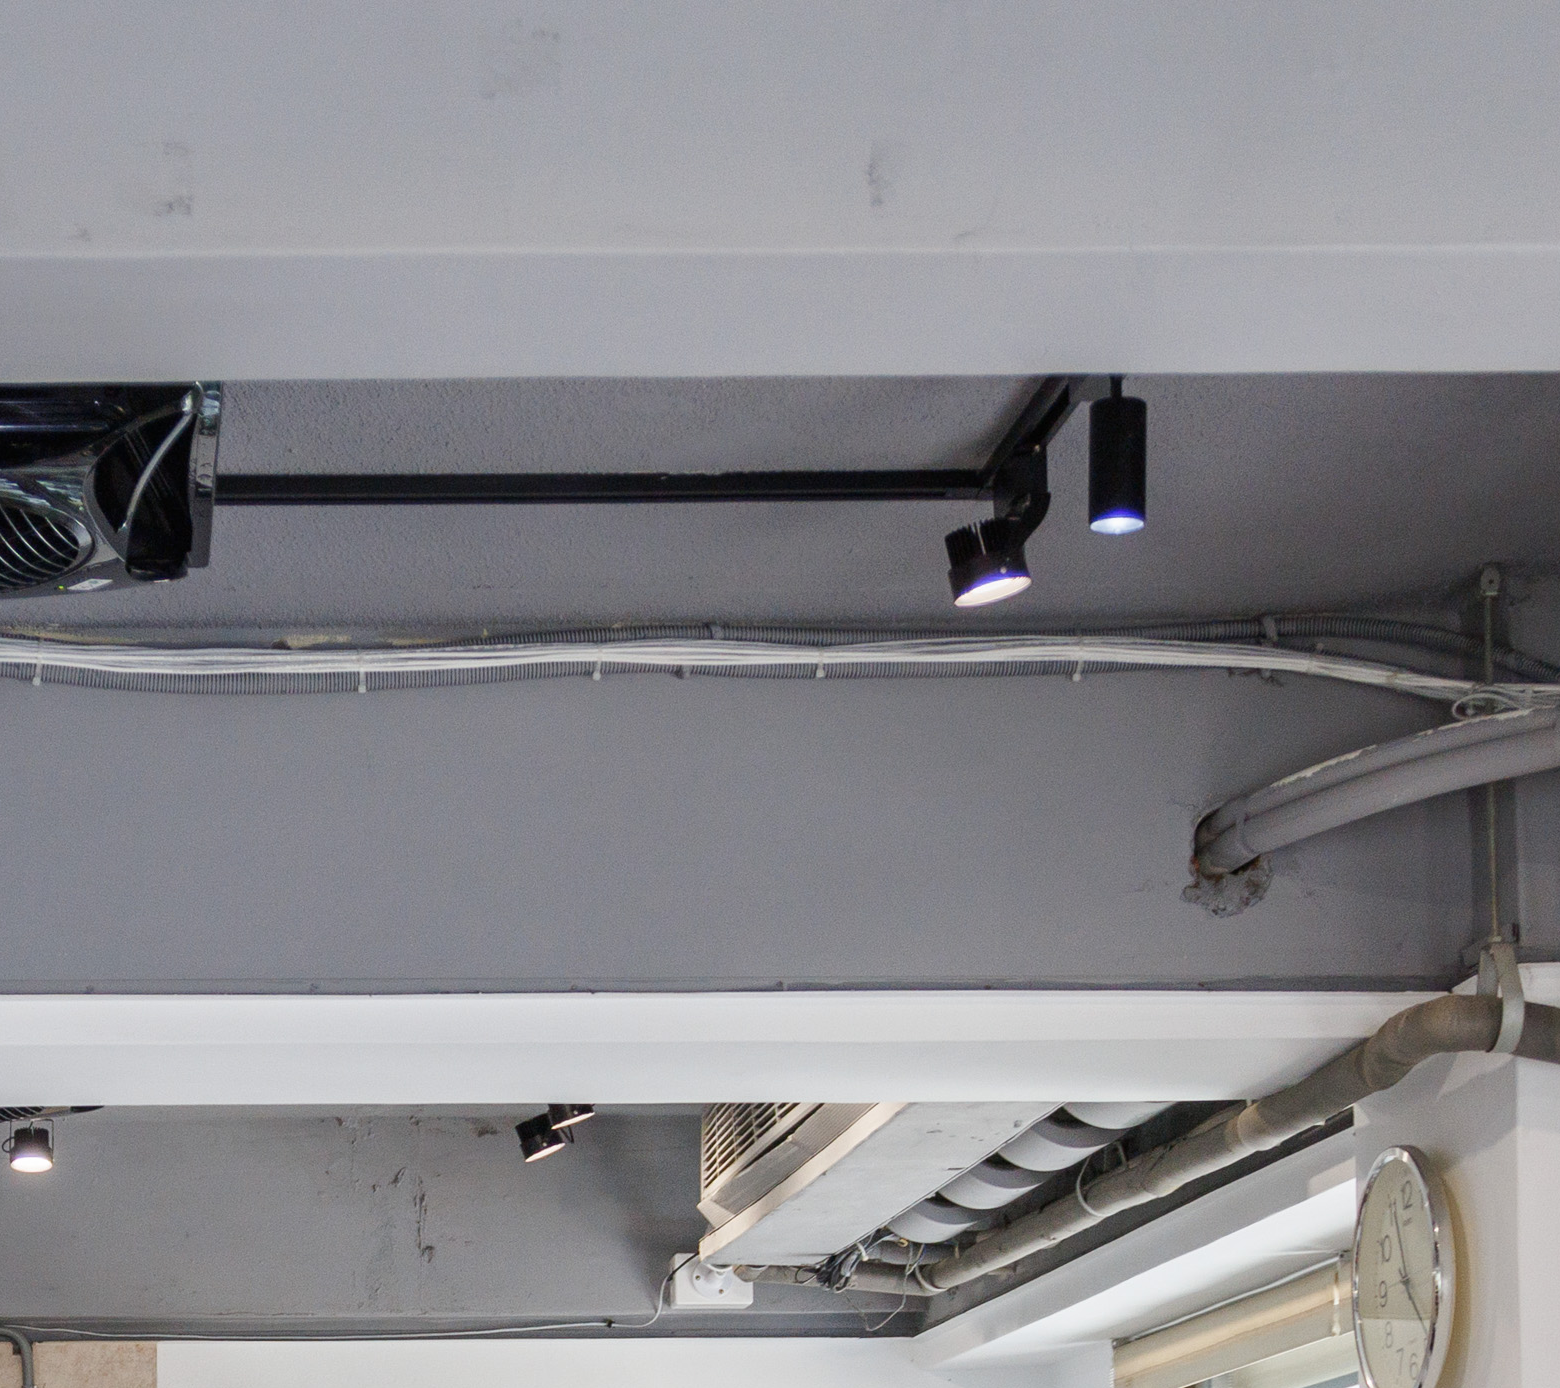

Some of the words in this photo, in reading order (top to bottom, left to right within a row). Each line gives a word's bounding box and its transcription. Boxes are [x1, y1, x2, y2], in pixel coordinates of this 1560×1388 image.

[1400, 1180, 1413, 1210] 12
[1377, 1234, 1392, 1263] 10
[1379, 1280, 1388, 1307] 9
[1385, 1321, 1393, 1348] 8
[1396, 1347, 1405, 1376] 7
[1409, 1352, 1418, 1381] 6
